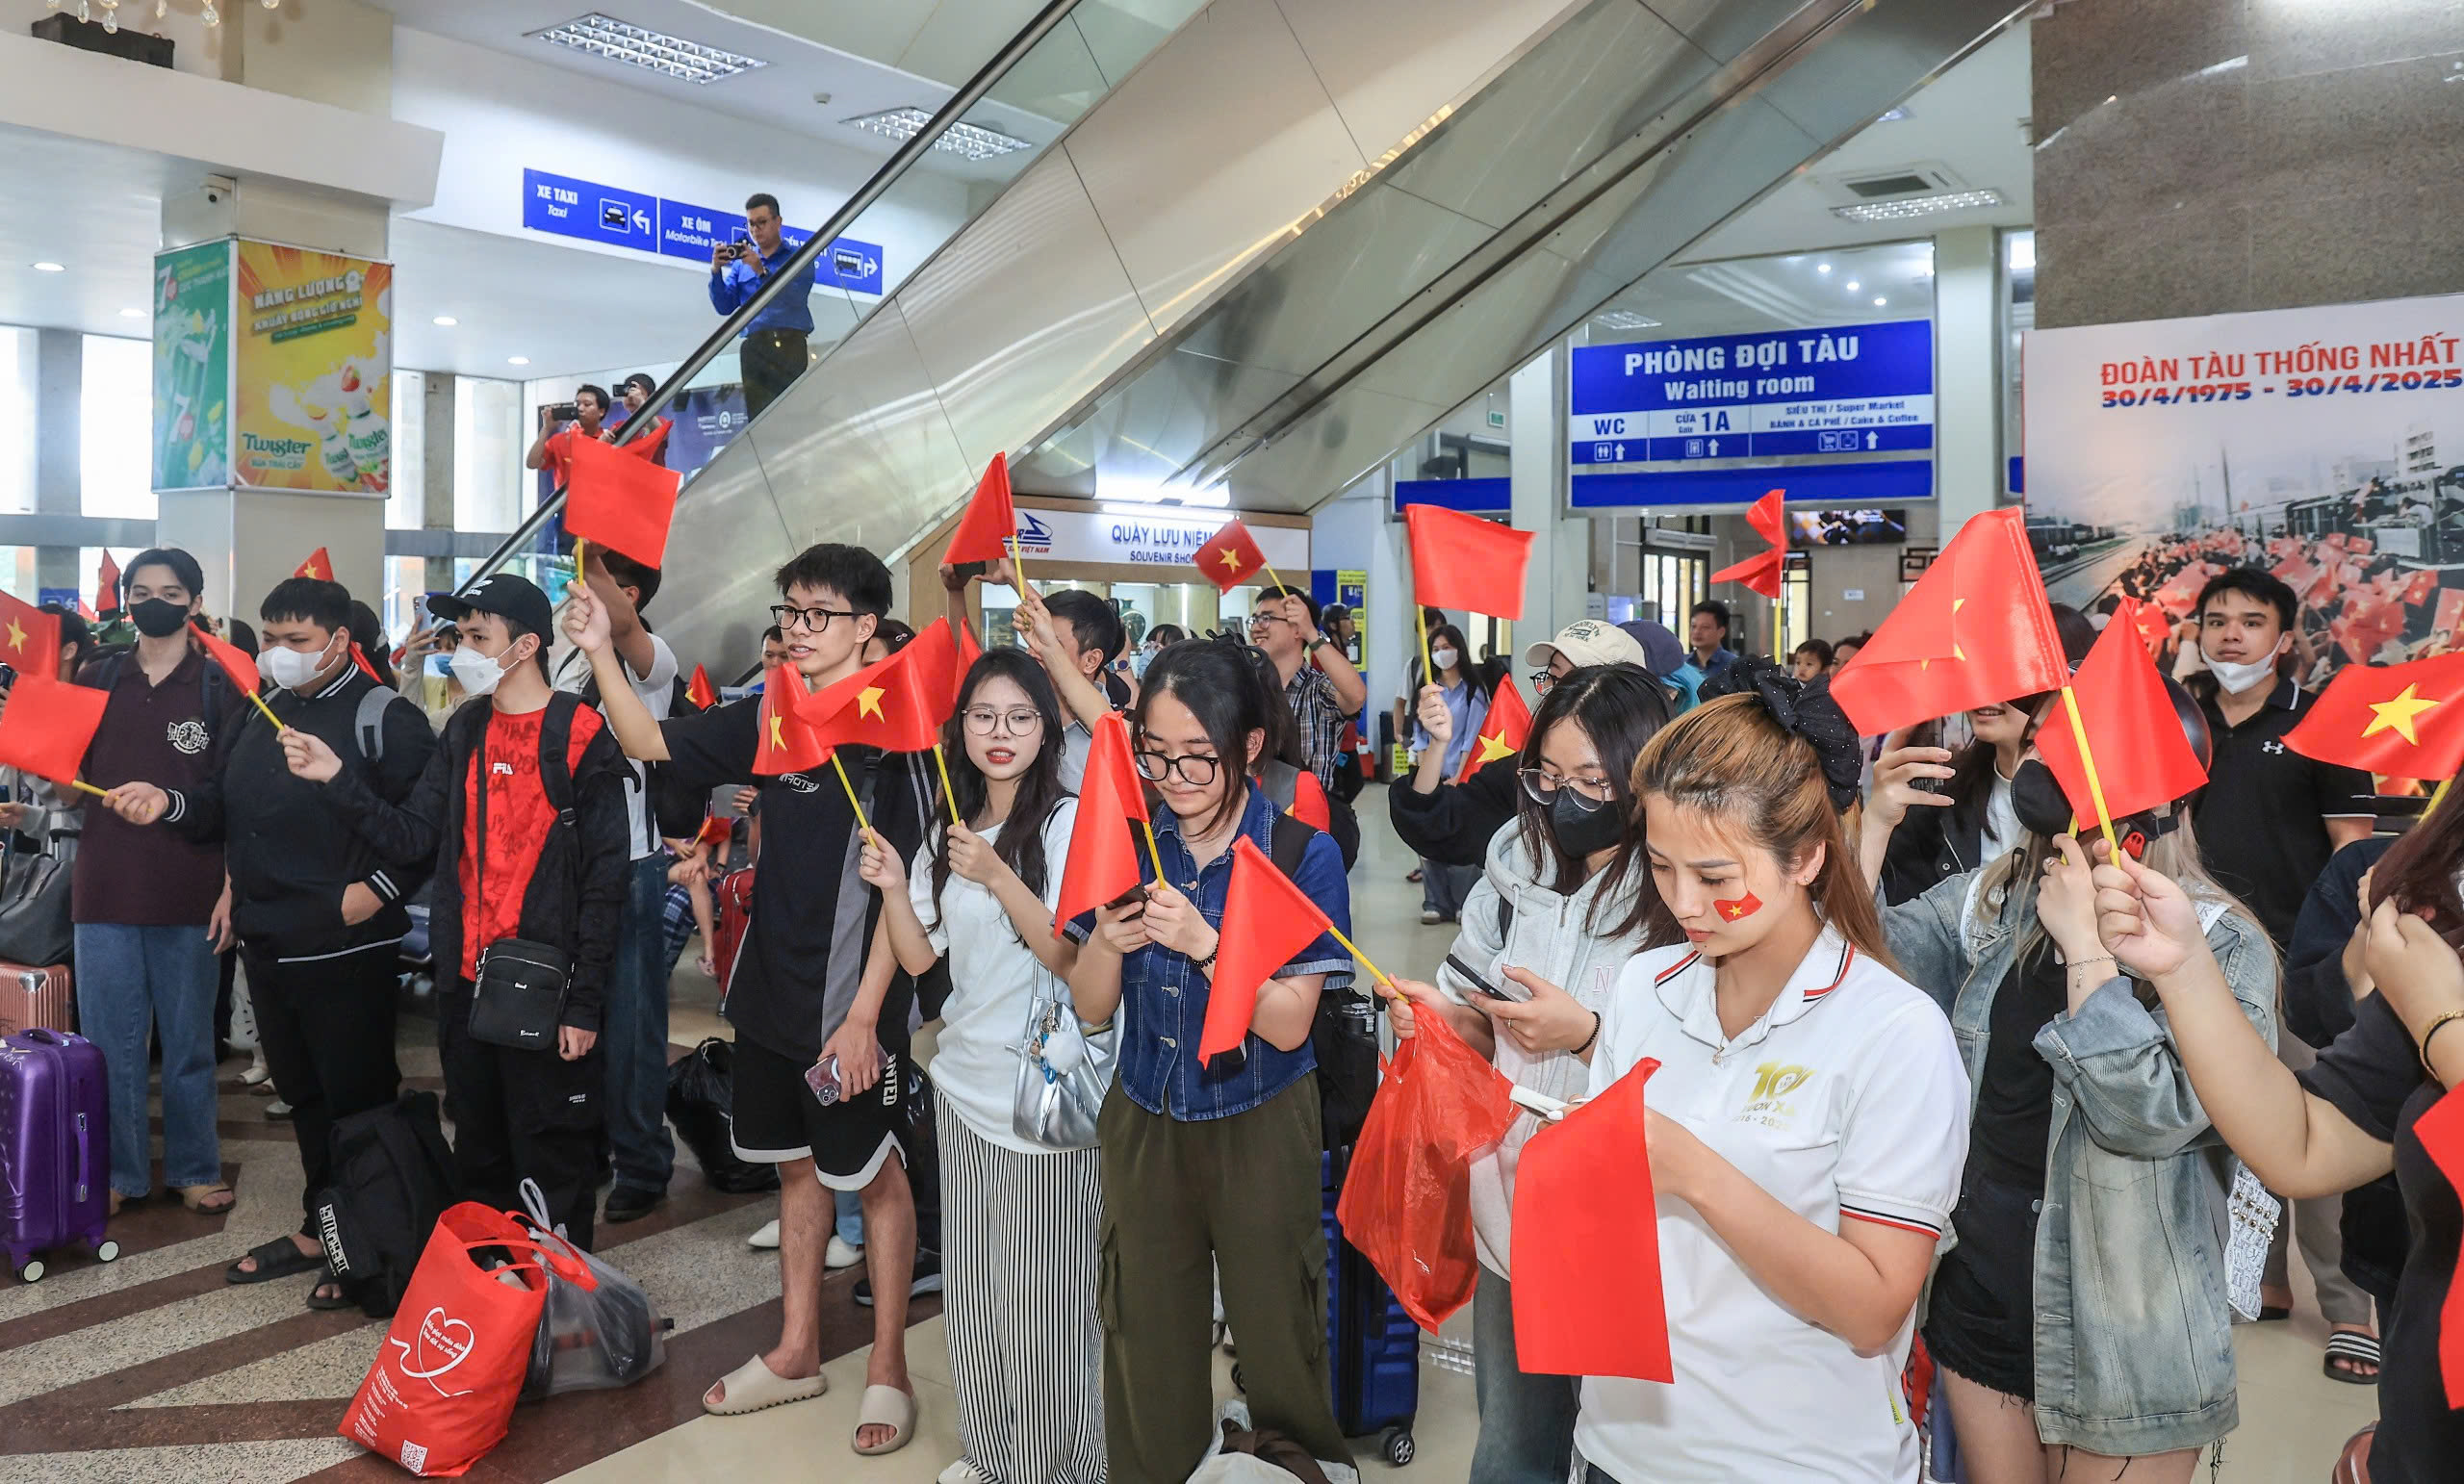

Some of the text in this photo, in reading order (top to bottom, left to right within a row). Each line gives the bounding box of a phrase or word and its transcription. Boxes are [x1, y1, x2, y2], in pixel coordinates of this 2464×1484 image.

[537, 184, 578, 205] XE TAXI
[548, 204, 568, 218] Taxi
[680, 216, 711, 233] XE ÔM
[665, 228, 709, 247] Motorbike
[1625, 334, 1860, 376] PHÒNG ĐỢI TÀU
[2100, 331, 2461, 386] ĐOÀN TÀU THỐNG NHẤT
[1665, 376, 1815, 401] Waiting room
[2101, 381, 2252, 408] 30/4/1975
[2286, 368, 2464, 398] 30/4/2025
[1836, 403, 1865, 414] Super
[1868, 400, 1905, 411] Market
[1594, 418, 1625, 435] WC
[1702, 410, 1731, 432] 1A
[1851, 415, 1875, 425] Cake
[1887, 413, 1919, 424] Coffee
[242, 433, 312, 457] Twister
[1153, 527, 1180, 545] LƯU
[1021, 545, 1035, 553] VIỆT
[1130, 550, 1172, 563] SOUVENIR
[493, 762, 514, 776] FILA
